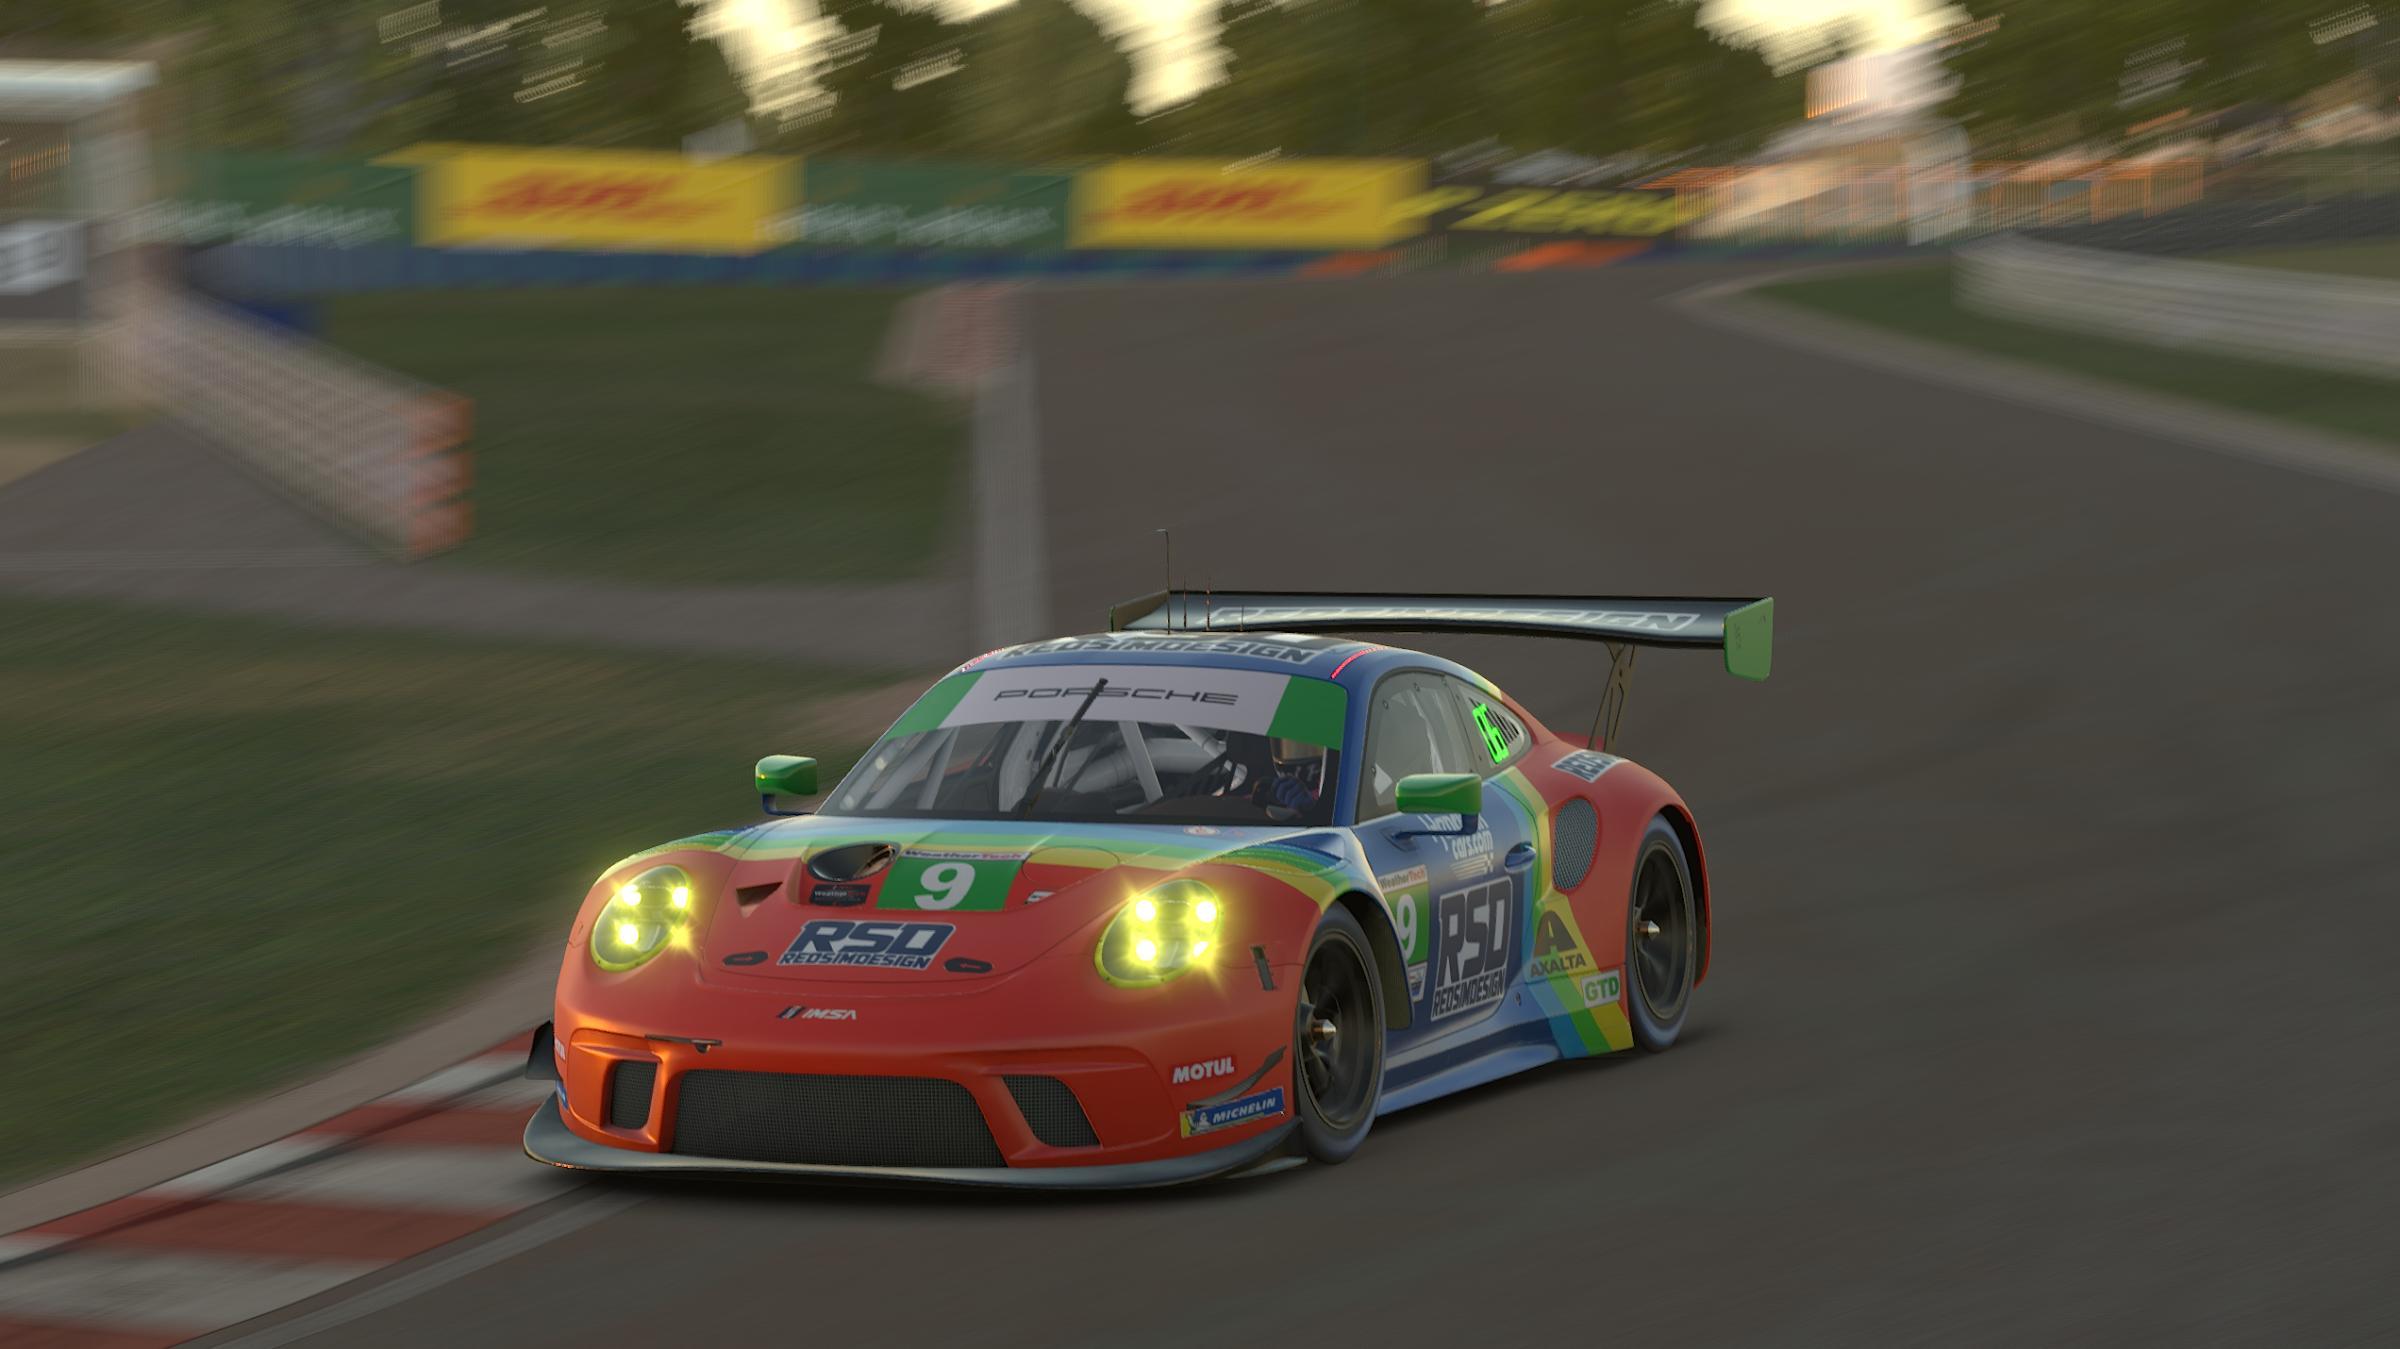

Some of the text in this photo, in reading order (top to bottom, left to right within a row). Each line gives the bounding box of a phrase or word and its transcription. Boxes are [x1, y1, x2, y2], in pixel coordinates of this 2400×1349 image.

[994, 687, 1240, 706] PORSCHE
[1452, 830, 1494, 861] cars.com
[914, 862, 976, 911] 9
[789, 921, 955, 955] RSD
[1396, 894, 1417, 960] 9
[1437, 880, 1512, 988] RSD
[780, 951, 931, 969] REDSIMDESIGN
[1530, 954, 1587, 977] AXALTA
[1432, 969, 1506, 1016] REDSIMDESIGN
[1584, 976, 1620, 1002] GTD
[801, 1008, 857, 1020] IMSA
[1173, 1057, 1235, 1084] MOTUL
[1212, 1097, 1276, 1123] MICHELIN
